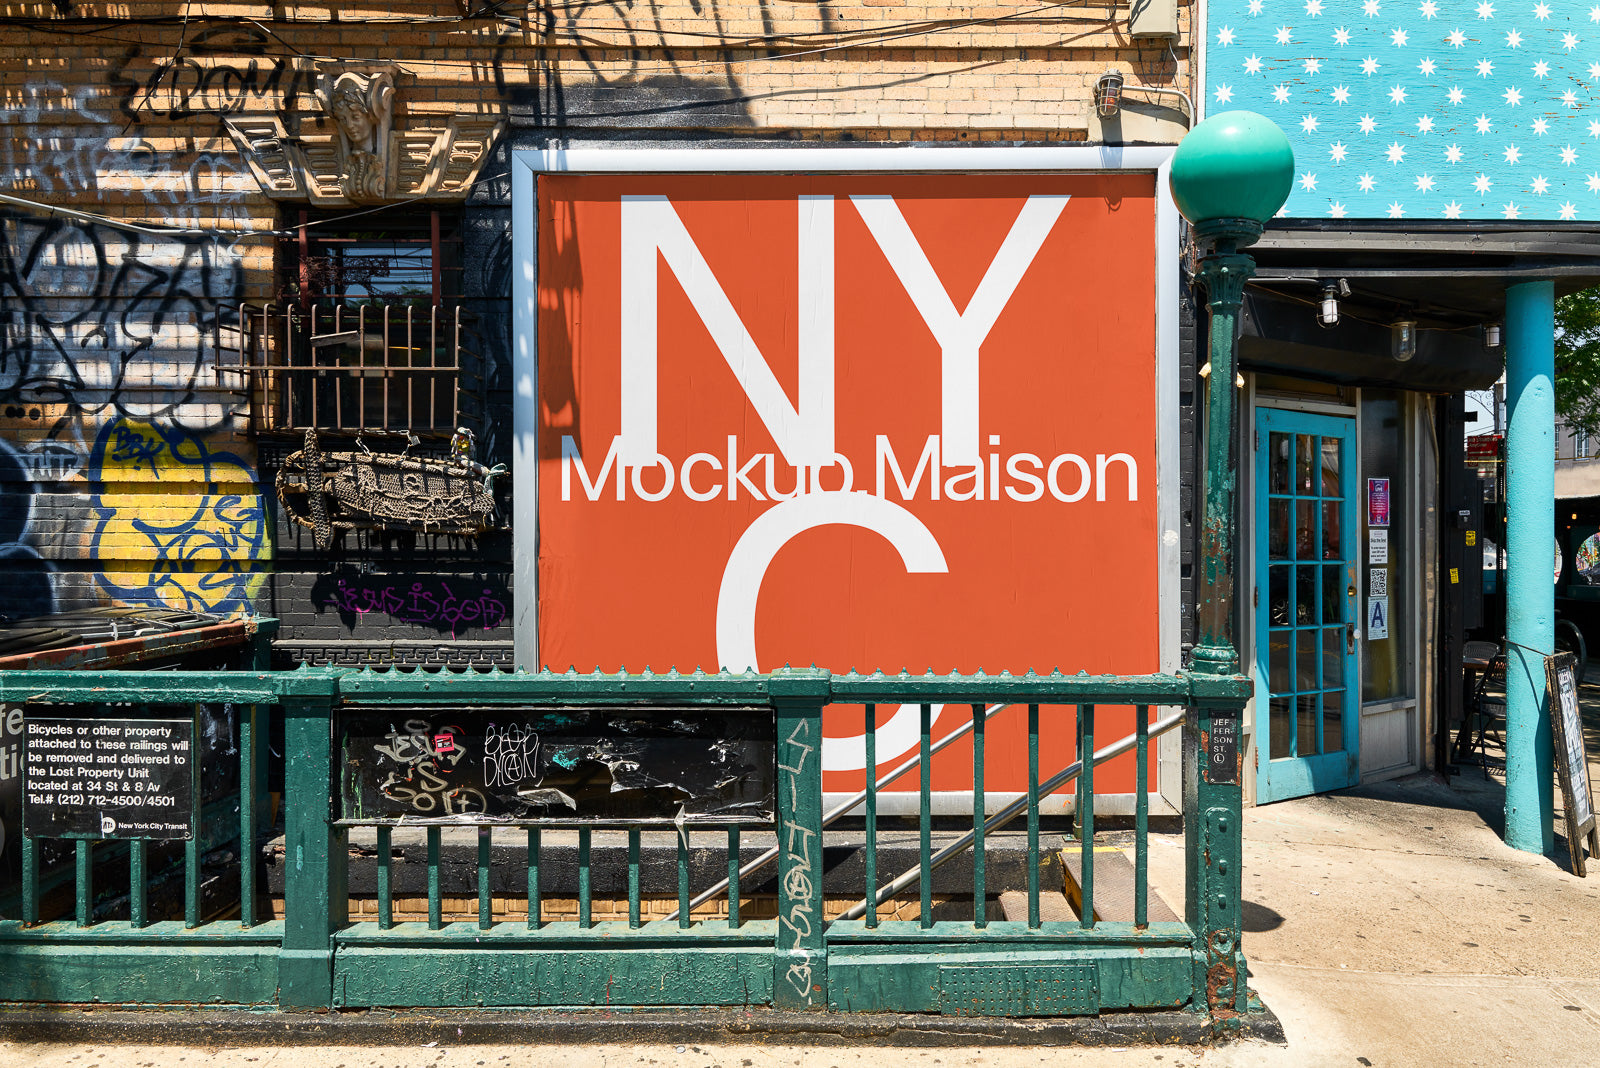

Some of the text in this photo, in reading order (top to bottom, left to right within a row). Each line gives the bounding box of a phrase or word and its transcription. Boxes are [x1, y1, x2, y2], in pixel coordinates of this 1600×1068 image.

[620, 195, 1070, 467] NY
[562, 434, 1138, 502] MockupMaison
[1371, 601, 1385, 628] A
[716, 490, 949, 771] C
[29, 724, 172, 738] Bicycles or other property
[28, 738, 189, 752] attached to these railings will
[1213, 736, 1233, 744] SON
[1213, 745, 1227, 753] ST.
[28, 752, 186, 765] be removed and delivered to
[28, 766, 150, 779] the Lost Property Unit
[28, 780, 161, 792] located at 34 St & 8 Av
[28, 794, 175, 807] Tel.# (212) 712-4500/4501
[133, 822, 149, 830] York
[149, 823, 164, 831] City
